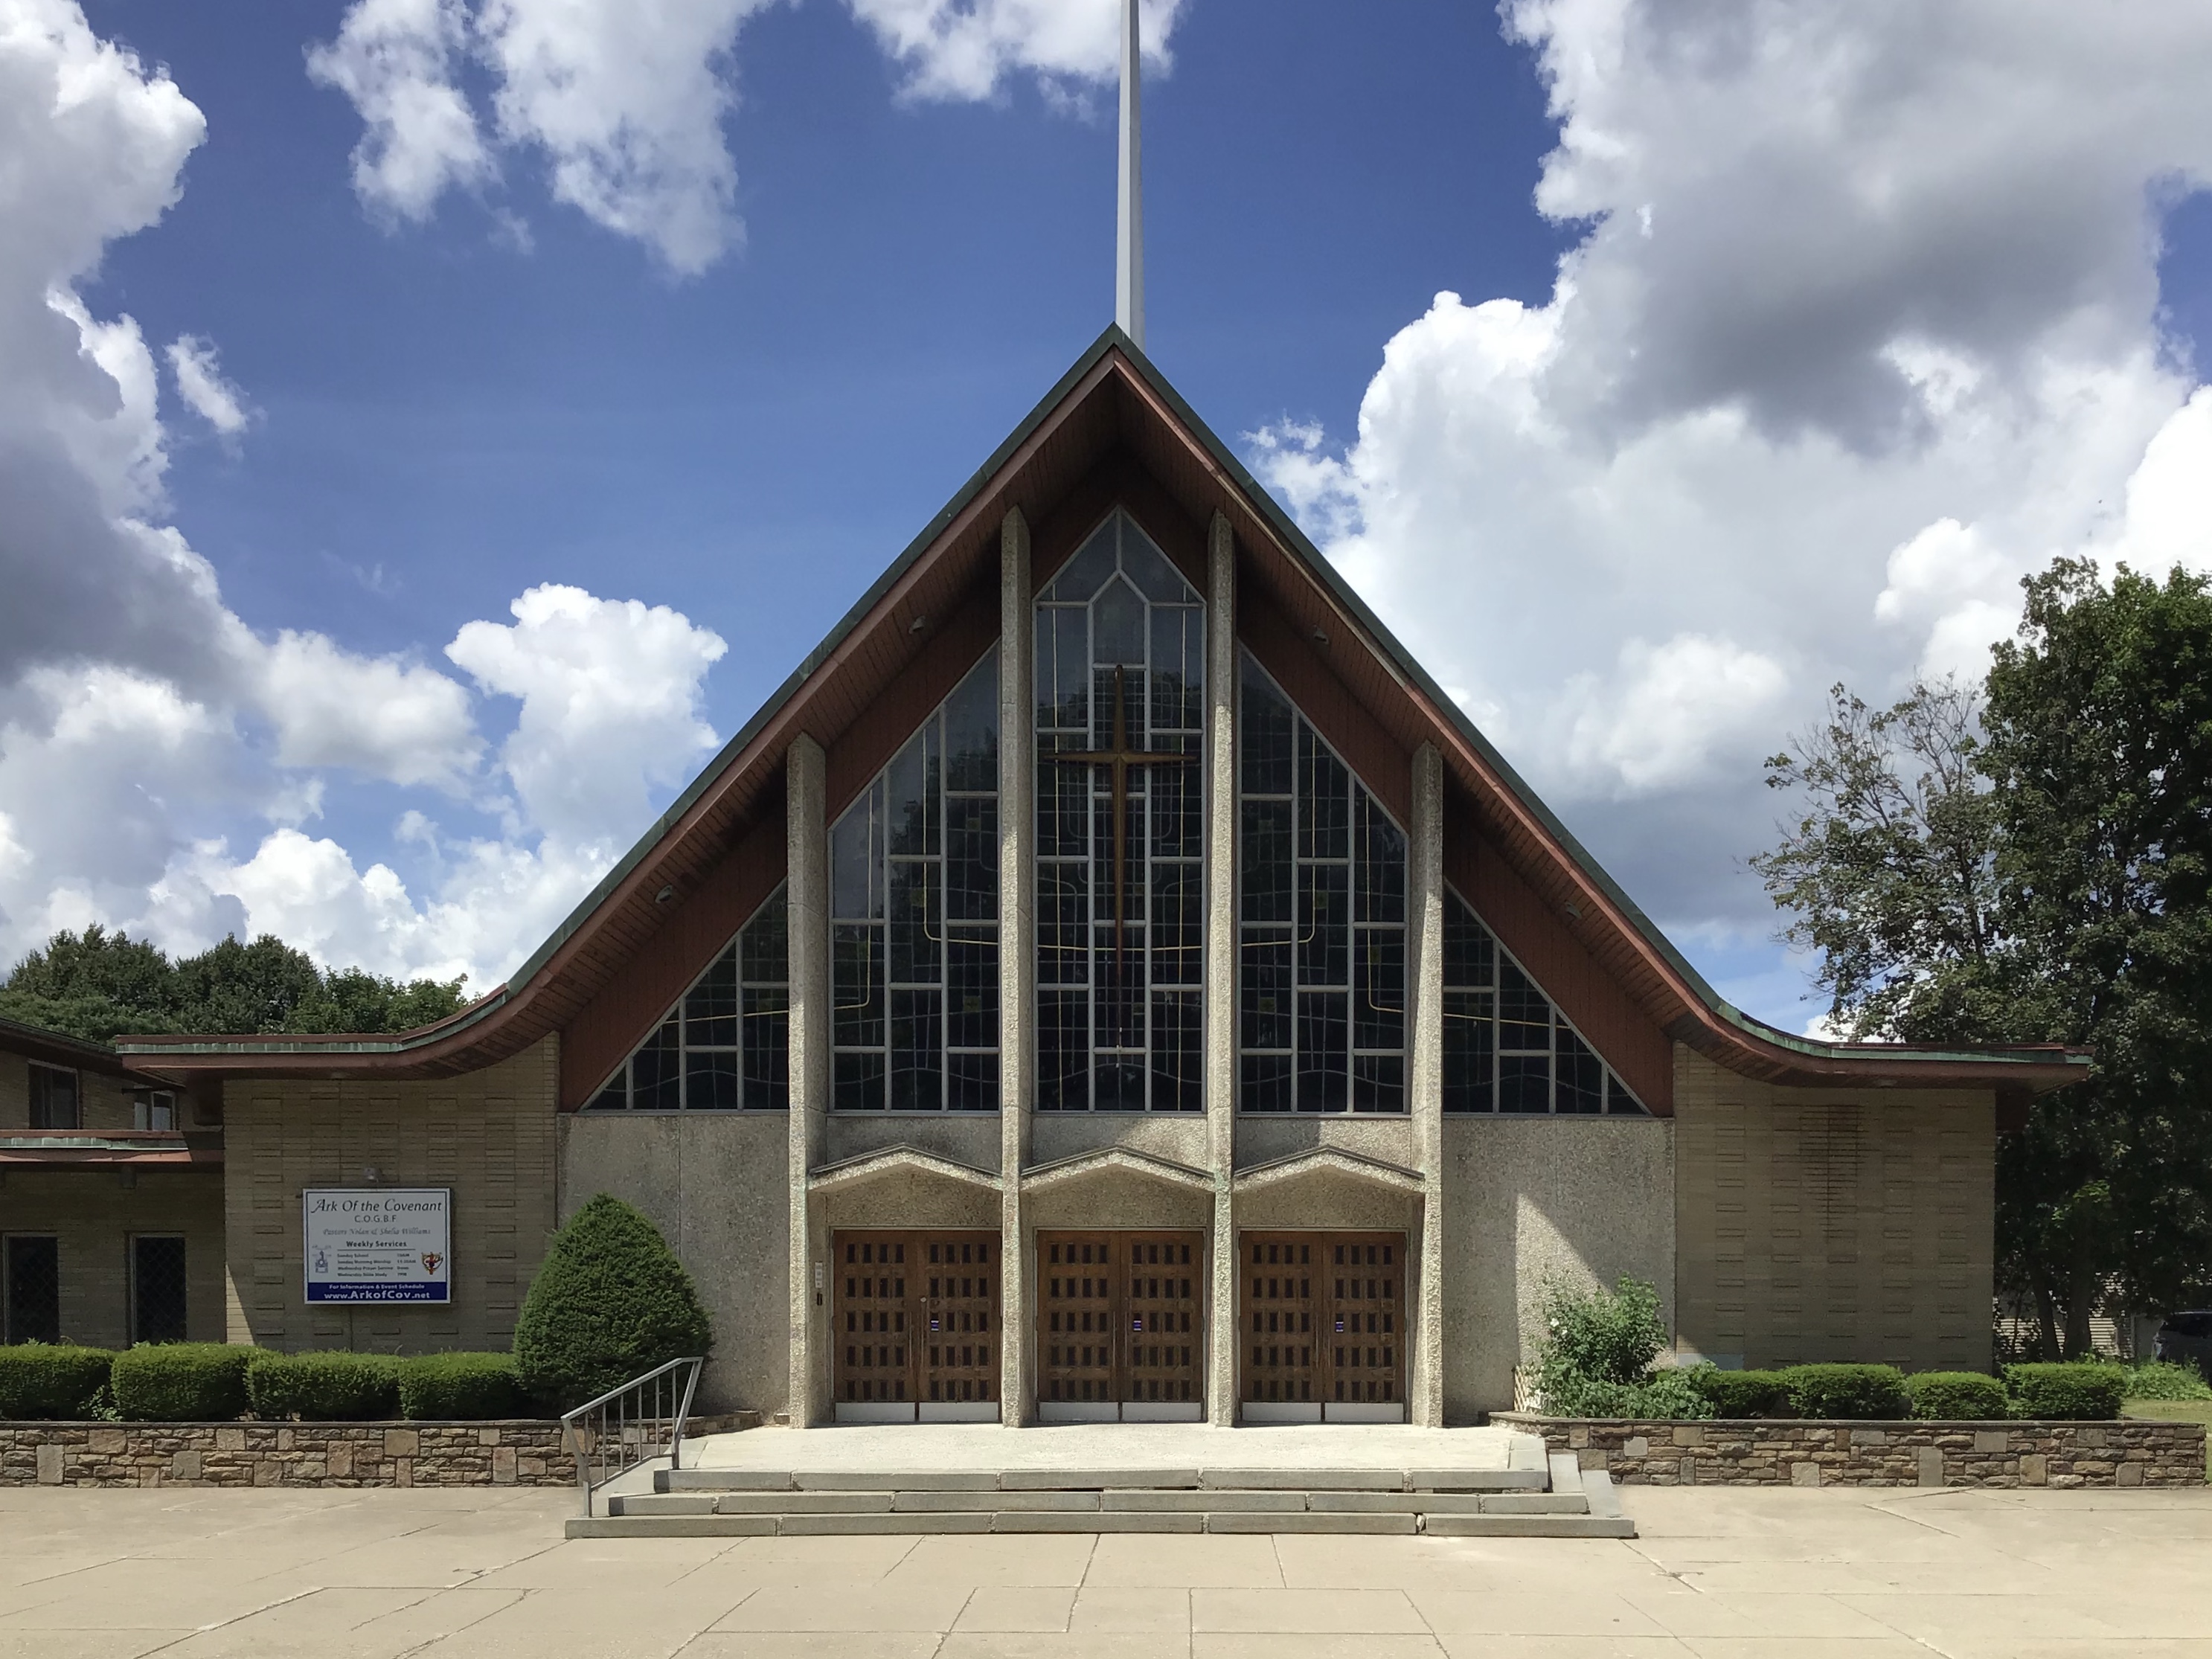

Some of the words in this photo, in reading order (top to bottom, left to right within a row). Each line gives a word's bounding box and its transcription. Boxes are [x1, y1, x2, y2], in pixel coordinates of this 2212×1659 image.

[311, 1198, 337, 1213] Ark
[342, 1200, 359, 1211] Of
[361, 1201, 379, 1211] the
[384, 1198, 442, 1211] Covenant
[402, 1227, 431, 1235] Williams
[324, 1290, 431, 1299] www.ArkofCov.net
